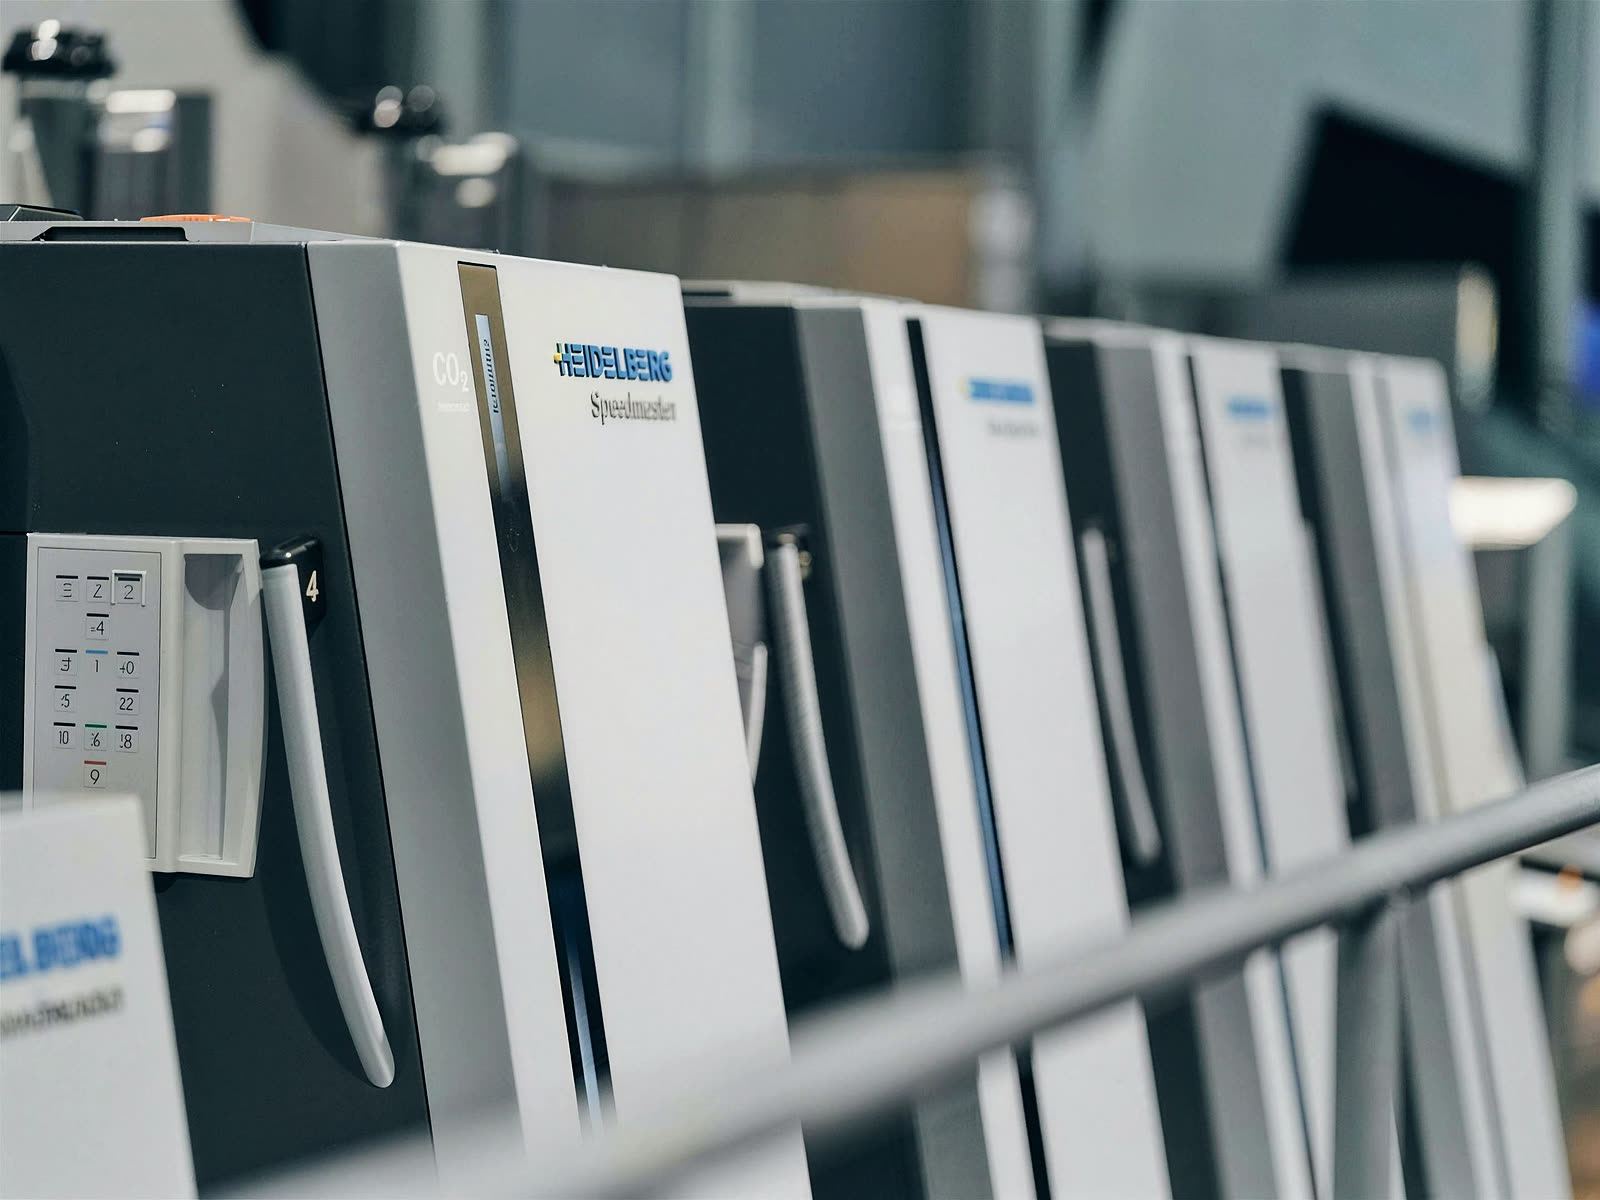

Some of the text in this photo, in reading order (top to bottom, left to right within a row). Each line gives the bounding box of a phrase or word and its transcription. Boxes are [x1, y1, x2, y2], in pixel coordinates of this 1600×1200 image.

[554, 342, 673, 382] HEIDELBERG
[123, 584, 134, 600] 2
[305, 570, 319, 602] 4
[94, 659, 99, 673] 1
[119, 697, 134, 711] 22
[59, 730, 69, 745] 10
[90, 768, 100, 785] 9
